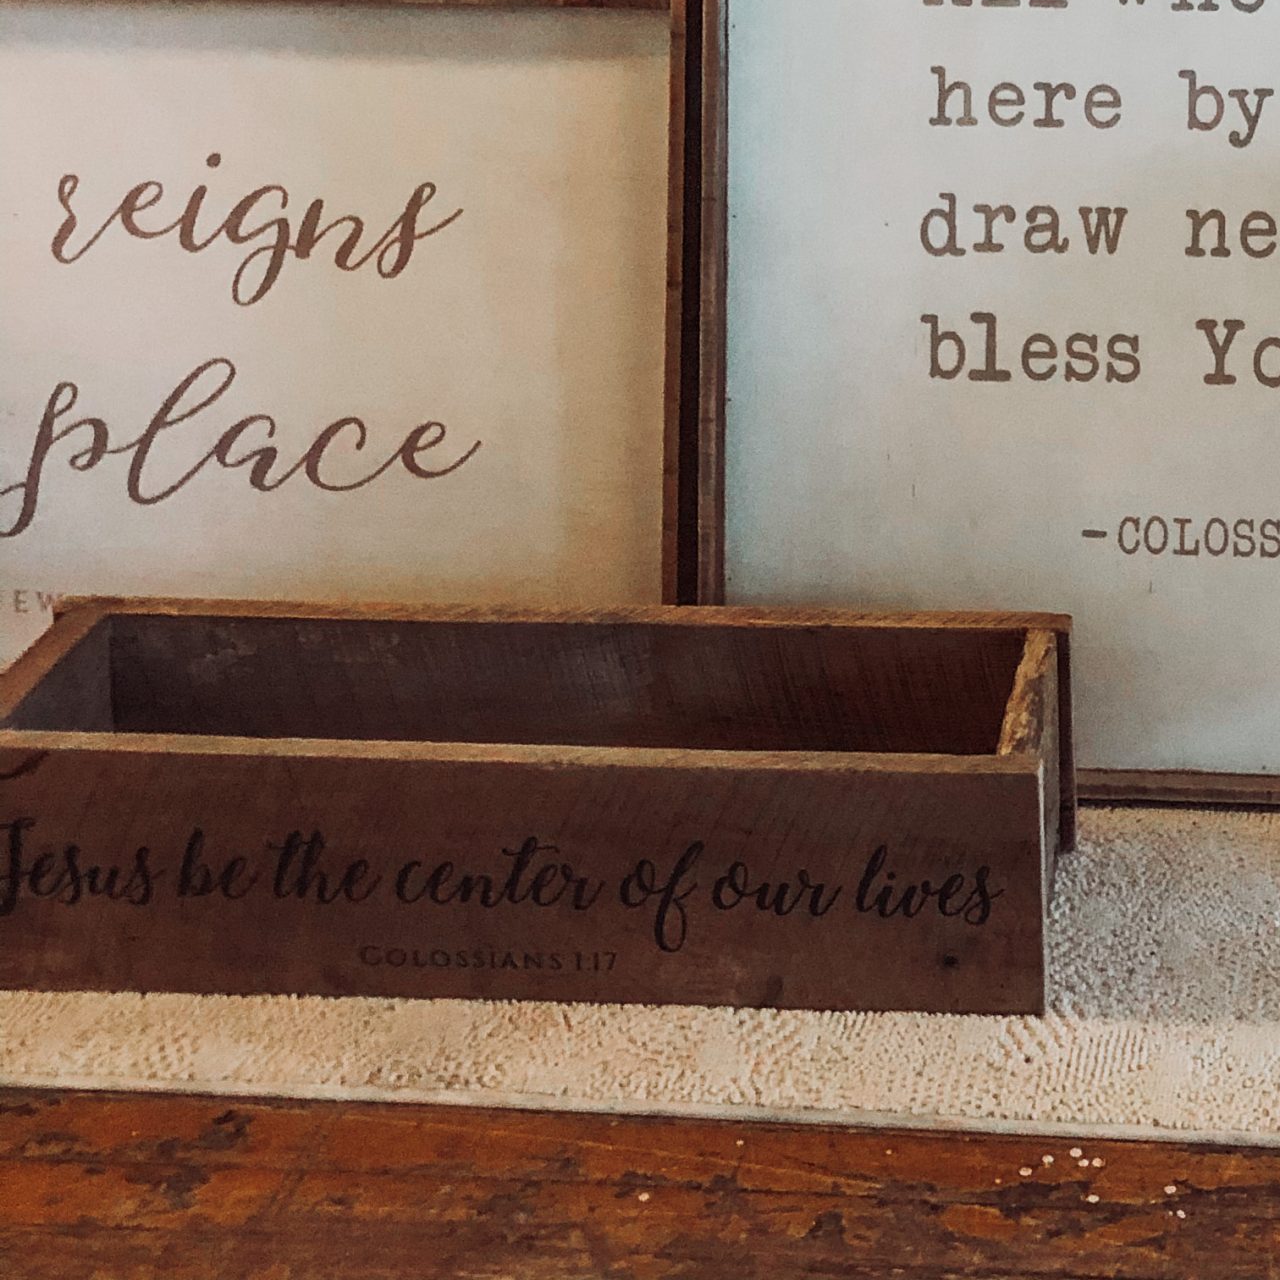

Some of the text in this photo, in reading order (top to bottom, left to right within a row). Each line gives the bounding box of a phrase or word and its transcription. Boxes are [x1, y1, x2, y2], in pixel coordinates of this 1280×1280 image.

[928, 66, 1123, 128] here
[1178, 71, 1274, 148] by
[51, 152, 464, 306] reigns
[920, 193, 1129, 257] draw
[921, 313, 1142, 383] bless
[0, 357, 482, 536] place
[0, 816, 1005, 952] Jesus be the center of our lives
